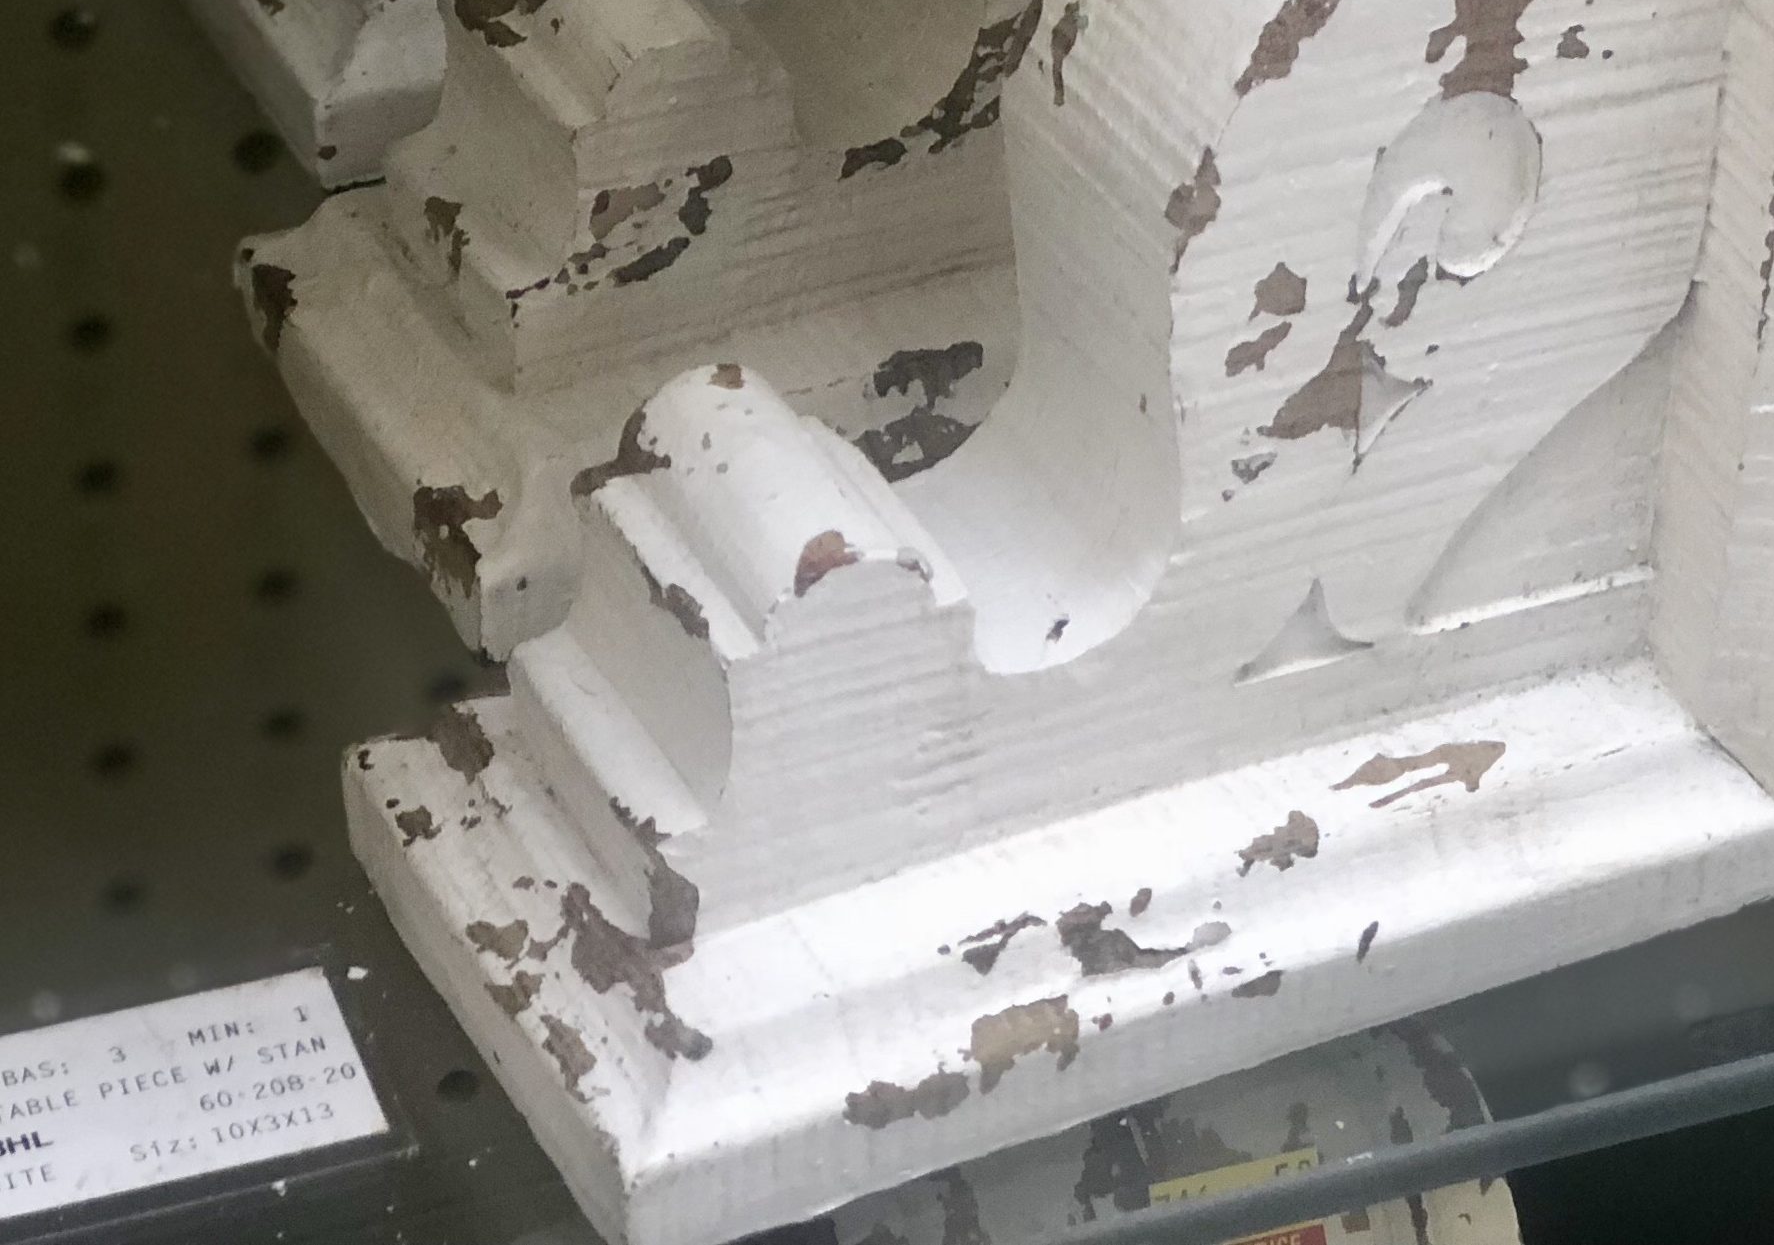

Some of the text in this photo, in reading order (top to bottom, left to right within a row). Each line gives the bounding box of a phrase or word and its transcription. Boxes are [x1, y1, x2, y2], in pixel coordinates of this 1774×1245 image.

[2, 1005, 308, 1087] BAS: 3 MIN: 1
[0, 1036, 326, 1122] ABLE PIECE W/ STAN
[200, 1062, 356, 1111] 60-208-20
[211, 1102, 334, 1146] 10X3X13
[0, 1161, 57, 1190] ITE
